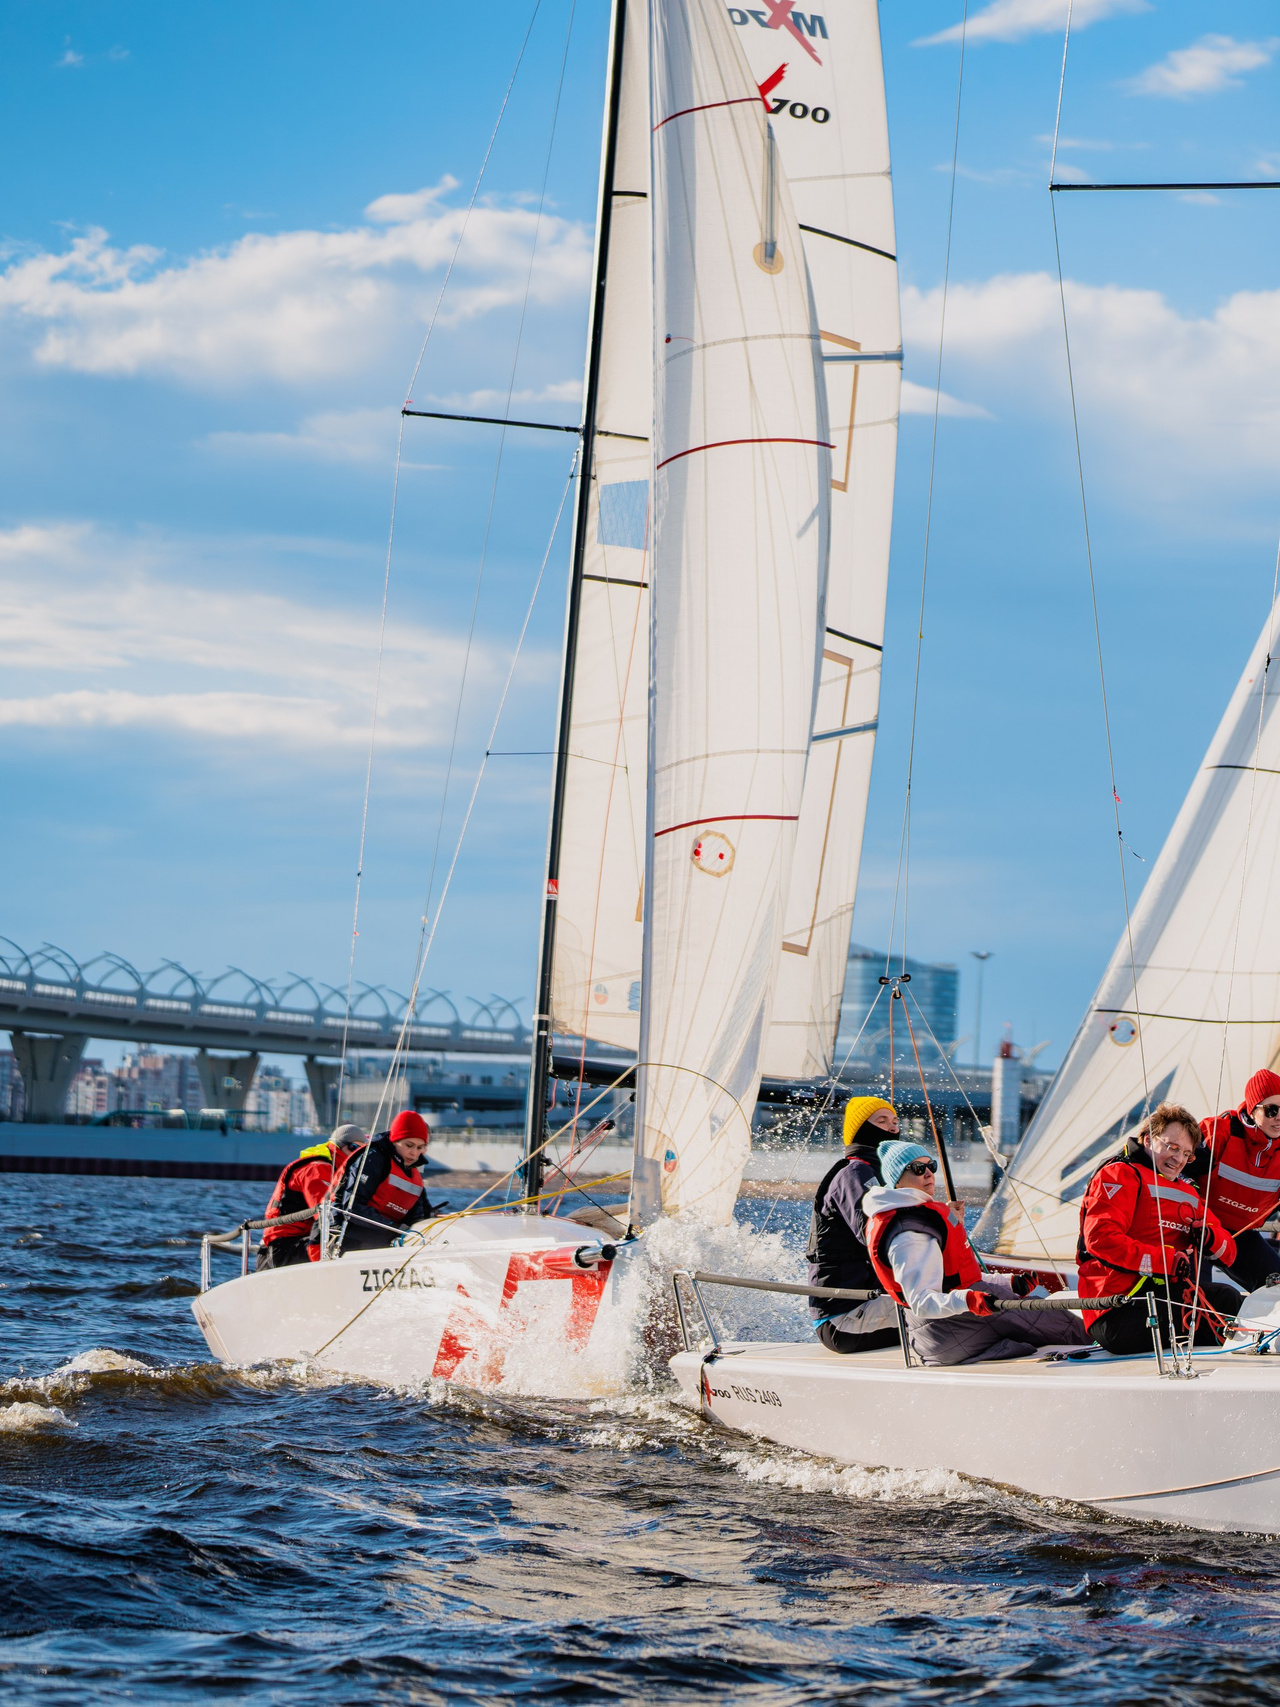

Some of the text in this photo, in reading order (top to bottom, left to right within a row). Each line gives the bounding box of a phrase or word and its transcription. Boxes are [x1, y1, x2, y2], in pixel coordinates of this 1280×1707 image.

[1218, 1195, 1259, 1213] ZIGZAG
[360, 1265, 436, 1292] ZIGZAG
[731, 1385, 757, 1403] RUS
[755, 1389, 782, 1408] 2409
